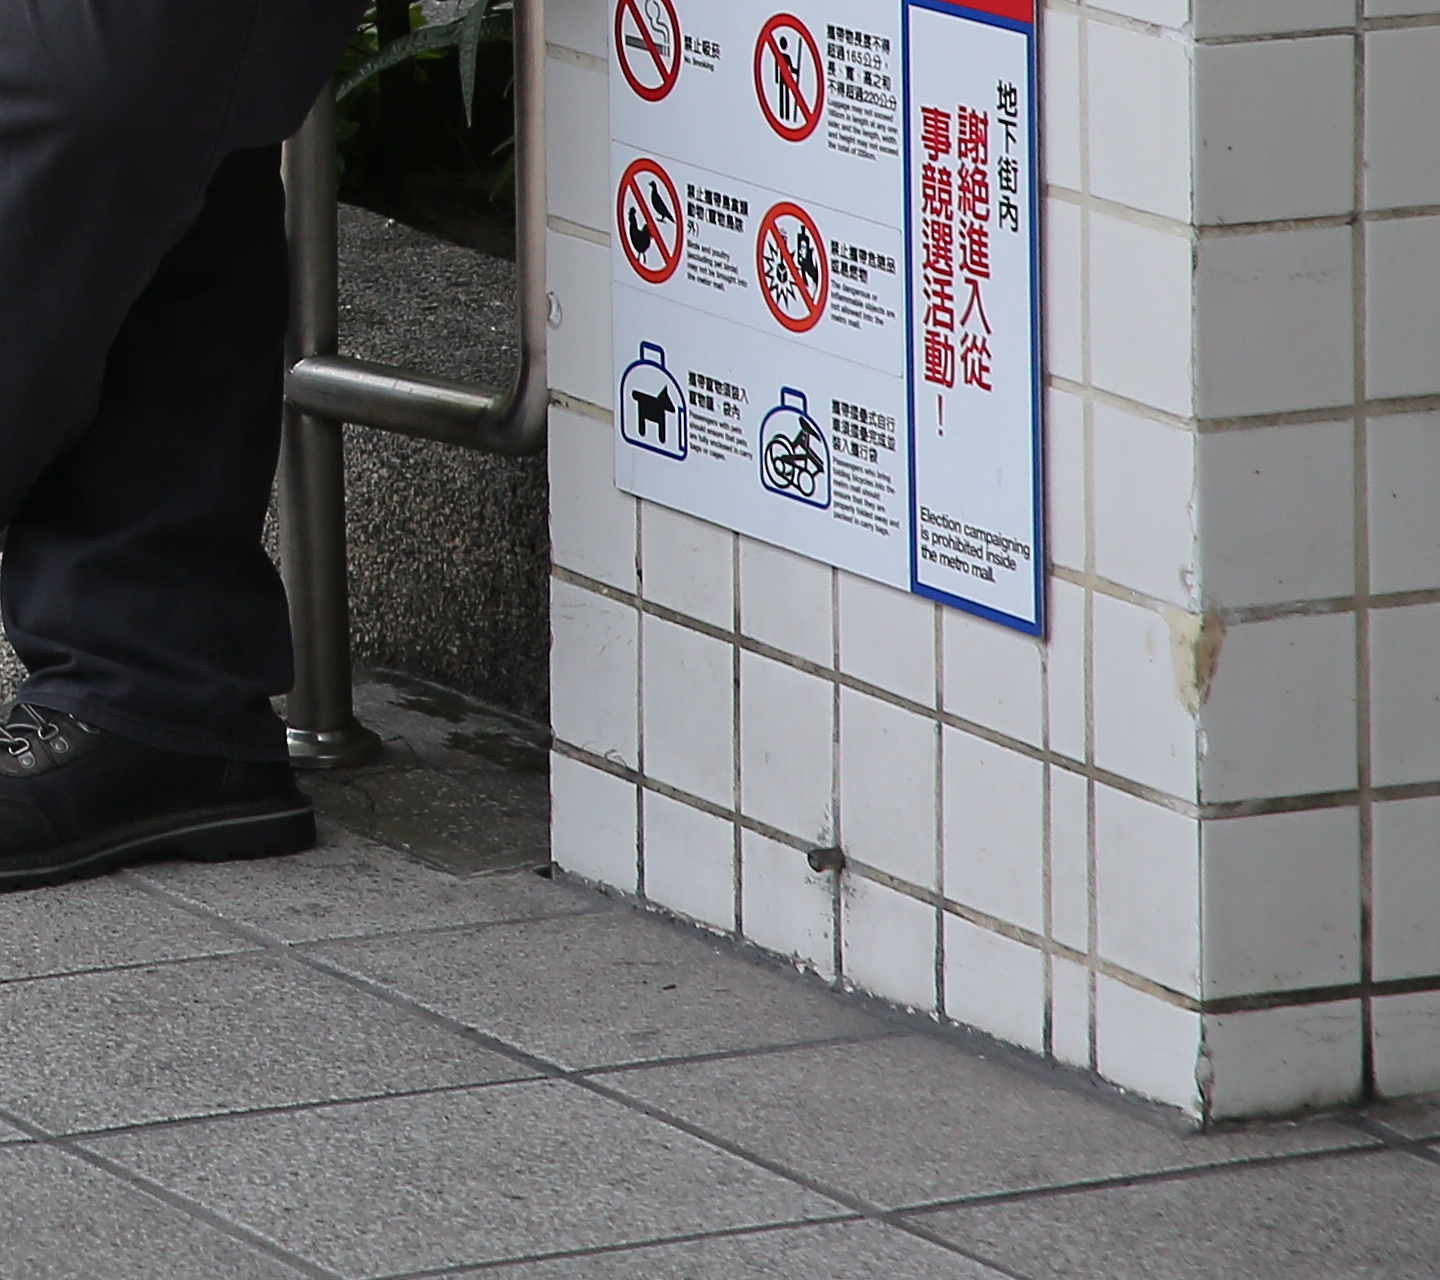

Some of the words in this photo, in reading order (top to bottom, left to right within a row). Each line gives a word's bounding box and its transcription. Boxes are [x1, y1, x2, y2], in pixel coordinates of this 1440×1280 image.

[996, 79, 1020, 233] 地下街內
[957, 105, 993, 391] 謝絕進入從
[920, 506, 961, 534] Election
[964, 524, 1030, 560] campaigning
[920, 524, 929, 541] is
[931, 532, 983, 560] prohibited
[986, 546, 1017, 571] inside
[920, 544, 937, 563] the
[939, 553, 969, 574] metro
